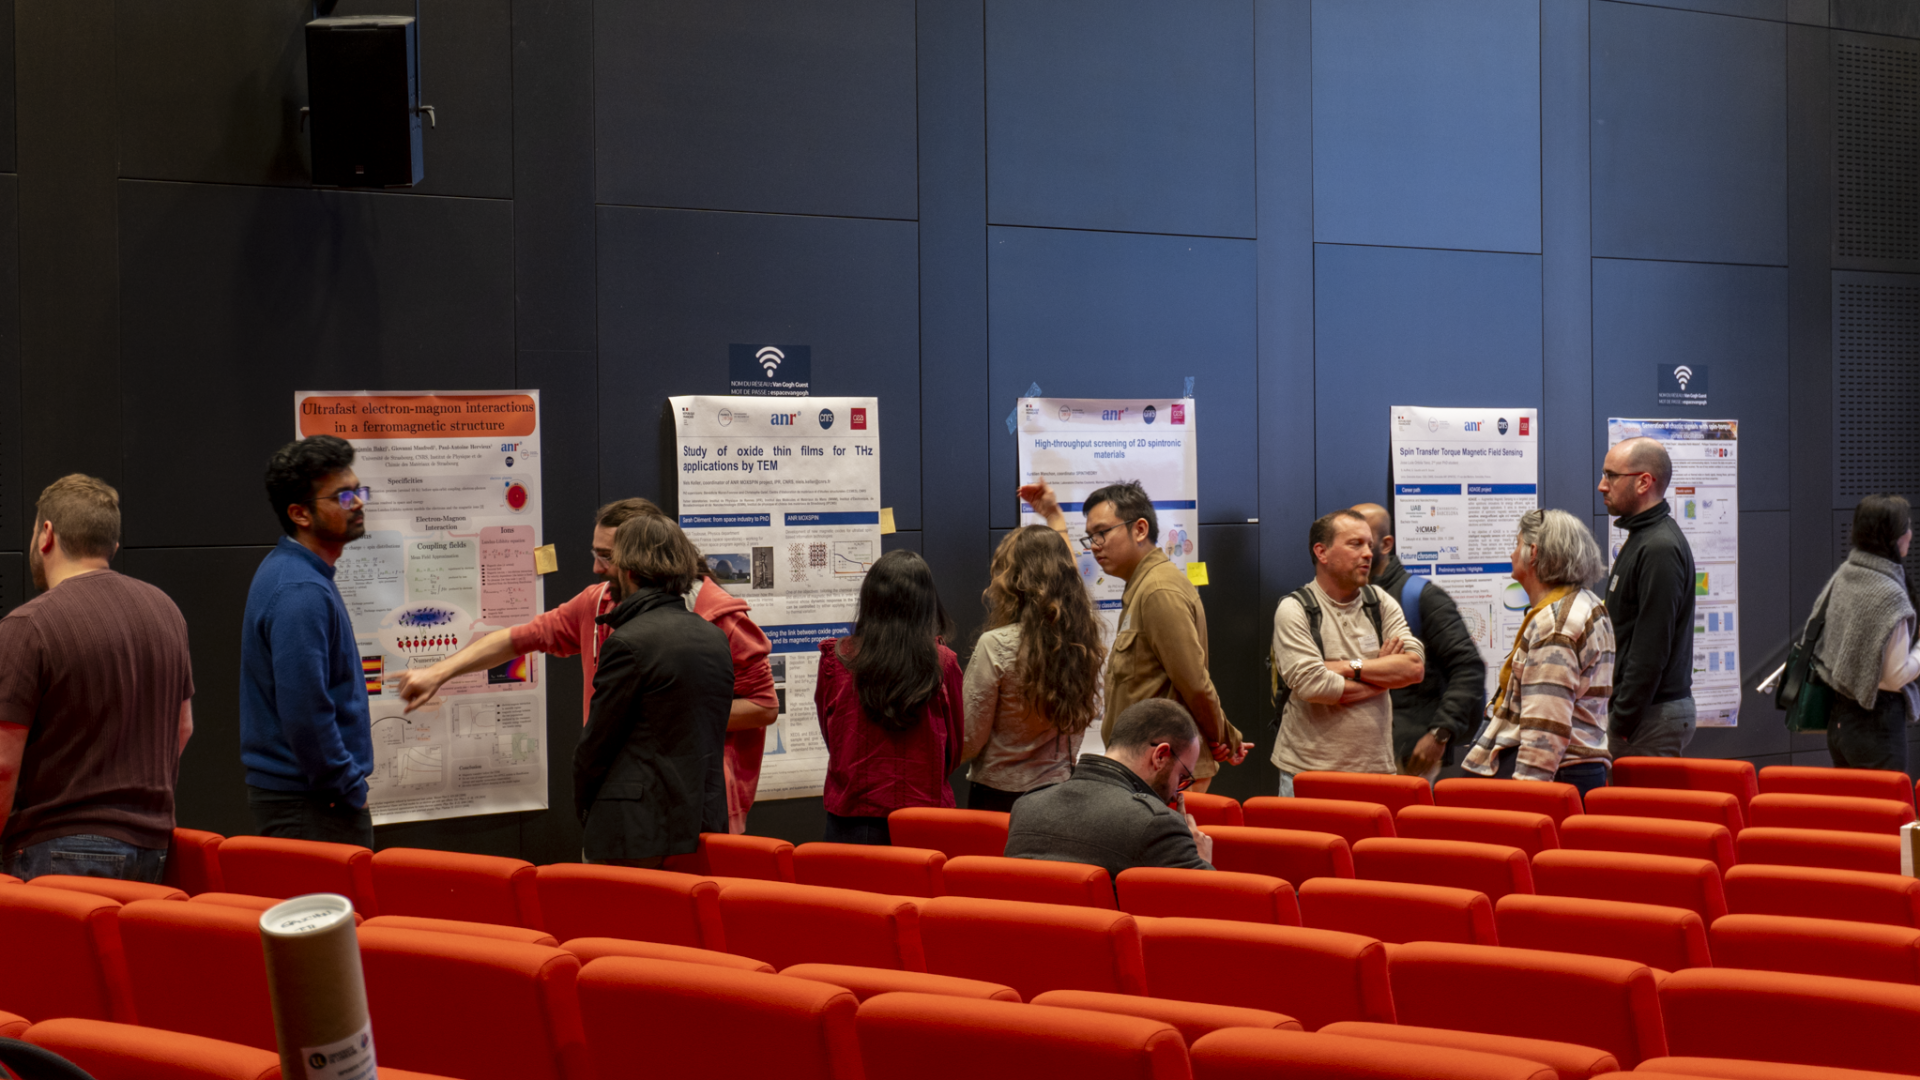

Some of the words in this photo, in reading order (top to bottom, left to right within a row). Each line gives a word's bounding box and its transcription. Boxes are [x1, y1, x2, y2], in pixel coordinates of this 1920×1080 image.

[302, 402, 357, 415] Ultrafast
[362, 402, 462, 416] electron-magnon
[466, 401, 534, 413] interactions
[771, 413, 796, 425] anr
[820, 414, 833, 422] cnrs
[1102, 410, 1124, 420] anr
[335, 421, 346, 433] in
[352, 424, 358, 432] a
[363, 420, 446, 434] ferromagnetic
[450, 420, 505, 431] structure
[1465, 421, 1482, 431] anr
[501, 443, 519, 452] anr
[1035, 439, 1092, 449] High-throughput
[1094, 439, 1127, 449] screening
[1129, 439, 1136, 447] of
[1137, 439, 1146, 447] 2D
[1148, 439, 1181, 449] spintronic
[684, 445, 707, 459] Study
[717, 445, 727, 456] of
[737, 446, 763, 456] oxide
[773, 446, 791, 456] thin
[801, 445, 824, 456] films
[833, 445, 846, 456] for
[855, 445, 873, 455] THz
[1094, 450, 1125, 458] materials
[1400, 447, 1414, 457] Spin
[1416, 447, 1439, 455] Transfer
[1441, 447, 1460, 457] Torque
[1462, 448, 1487, 457] Magnetic
[1488, 448, 1501, 456] Field
[1502, 448, 1523, 458] Sensing
[683, 460, 738, 473] applications
[742, 460, 754, 473] by
[757, 460, 778, 470] TEM
[737, 516, 754, 524] industry
[417, 543, 447, 551] Coupling
[832, 627, 849, 636] growth,
[789, 637, 810, 645] magnetic
[413, 656, 441, 664] Numerical
